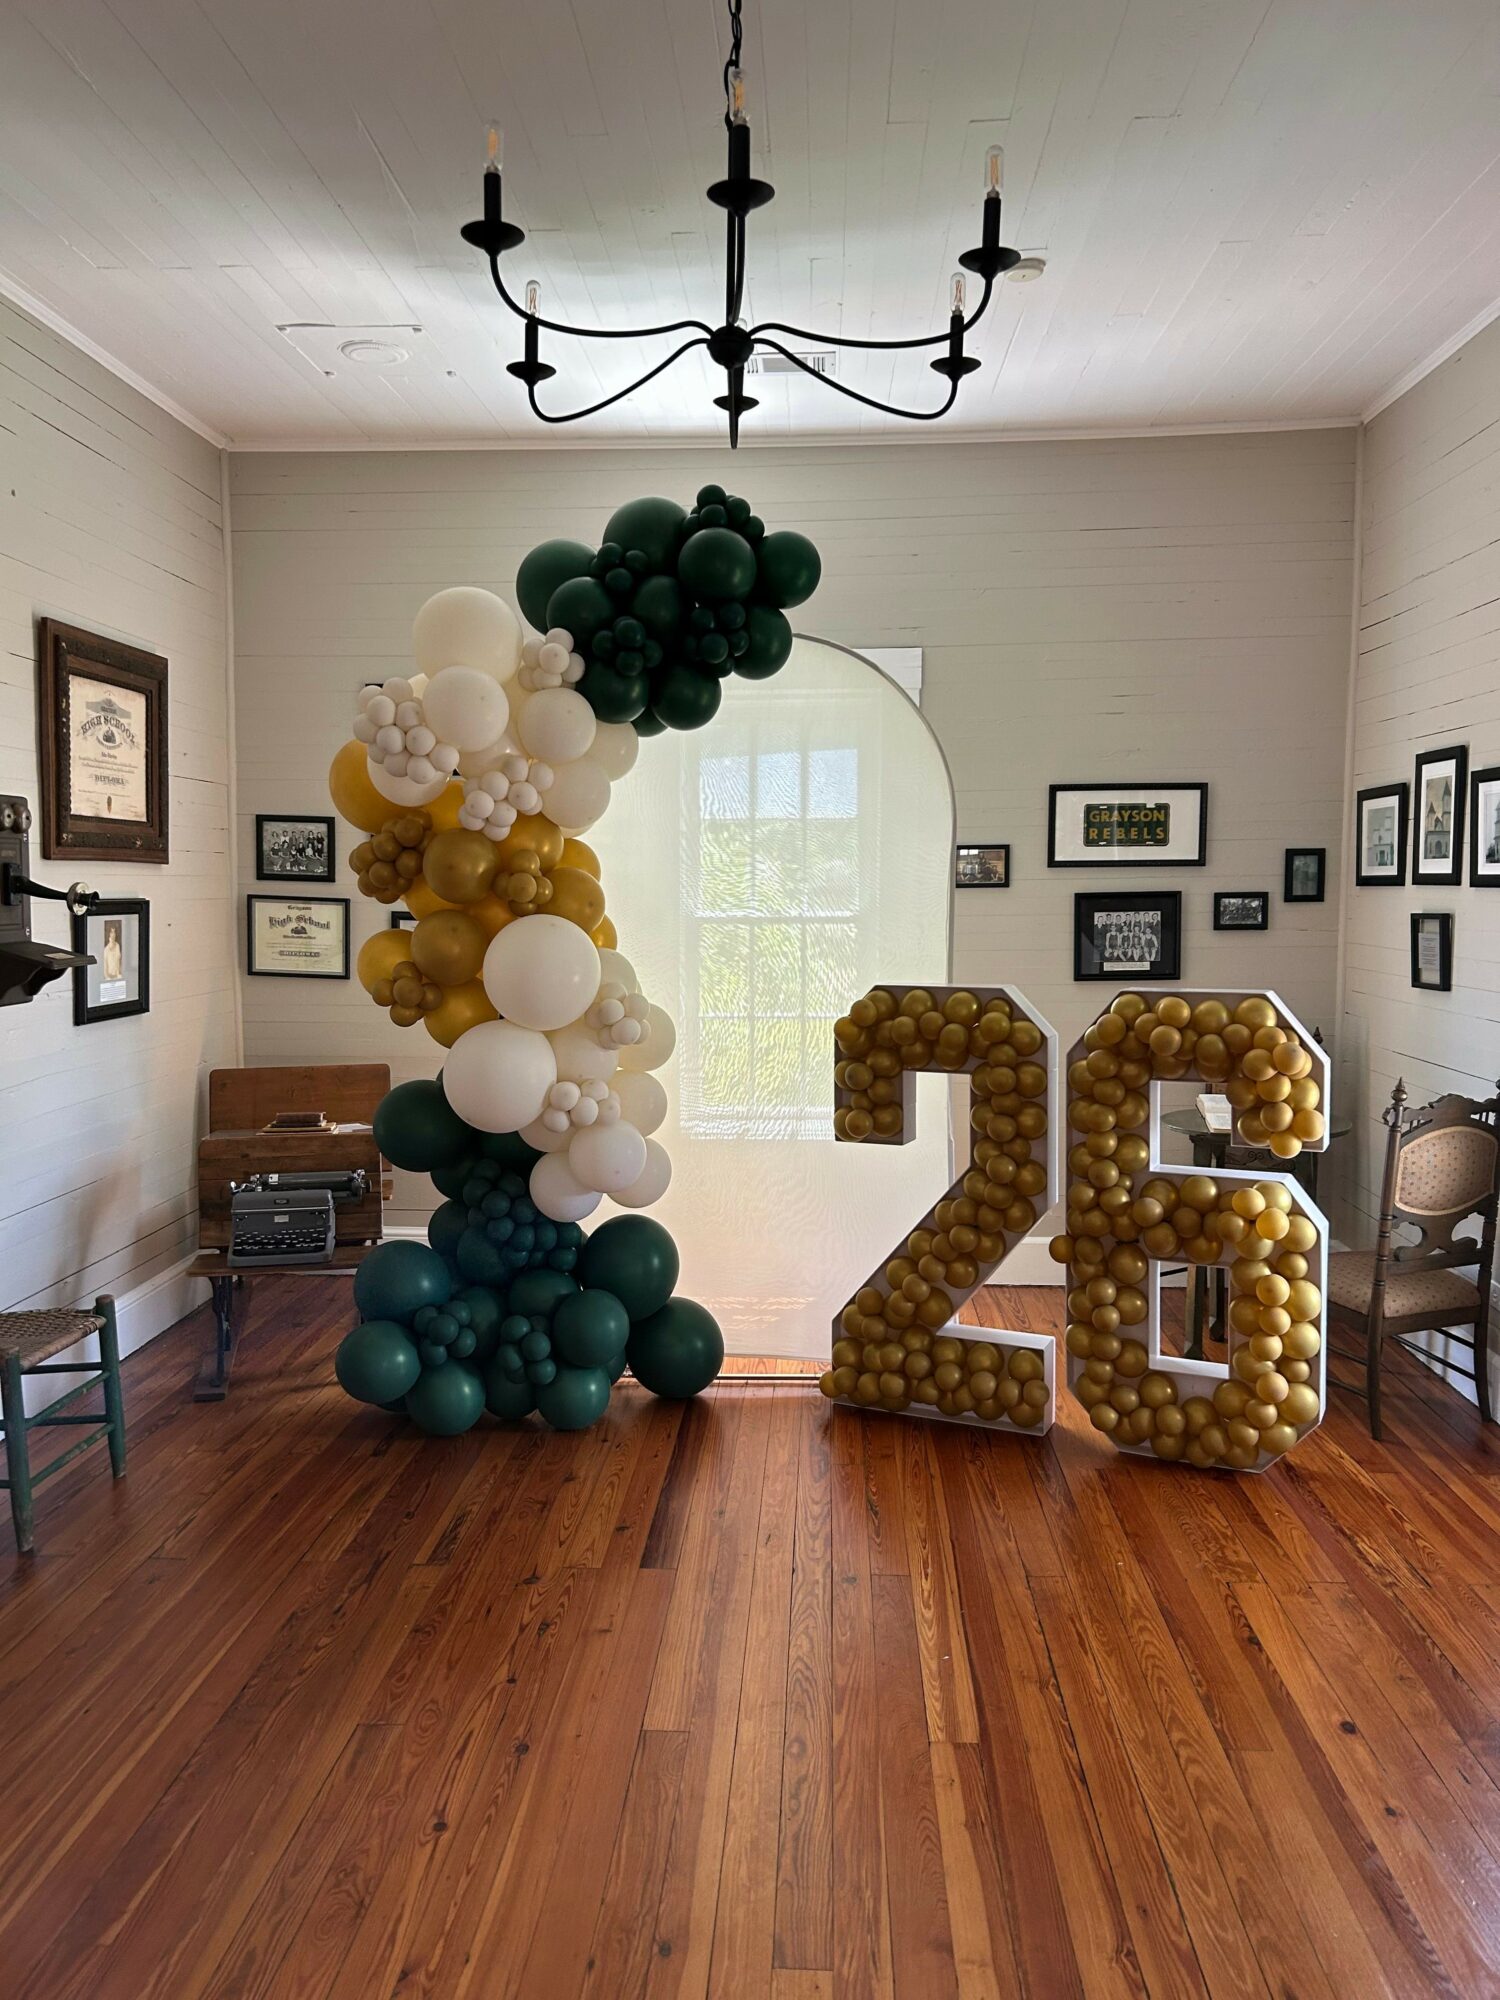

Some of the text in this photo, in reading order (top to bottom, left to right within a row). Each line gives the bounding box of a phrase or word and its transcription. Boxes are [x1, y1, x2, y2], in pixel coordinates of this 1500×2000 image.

[81, 715, 102, 735] HIGH
[103, 714, 135, 744] SCHOOL
[1089, 810, 1165, 822] GRAYSON
[1089, 827, 1165, 839] REBELS
[268, 914, 331, 930] High School
